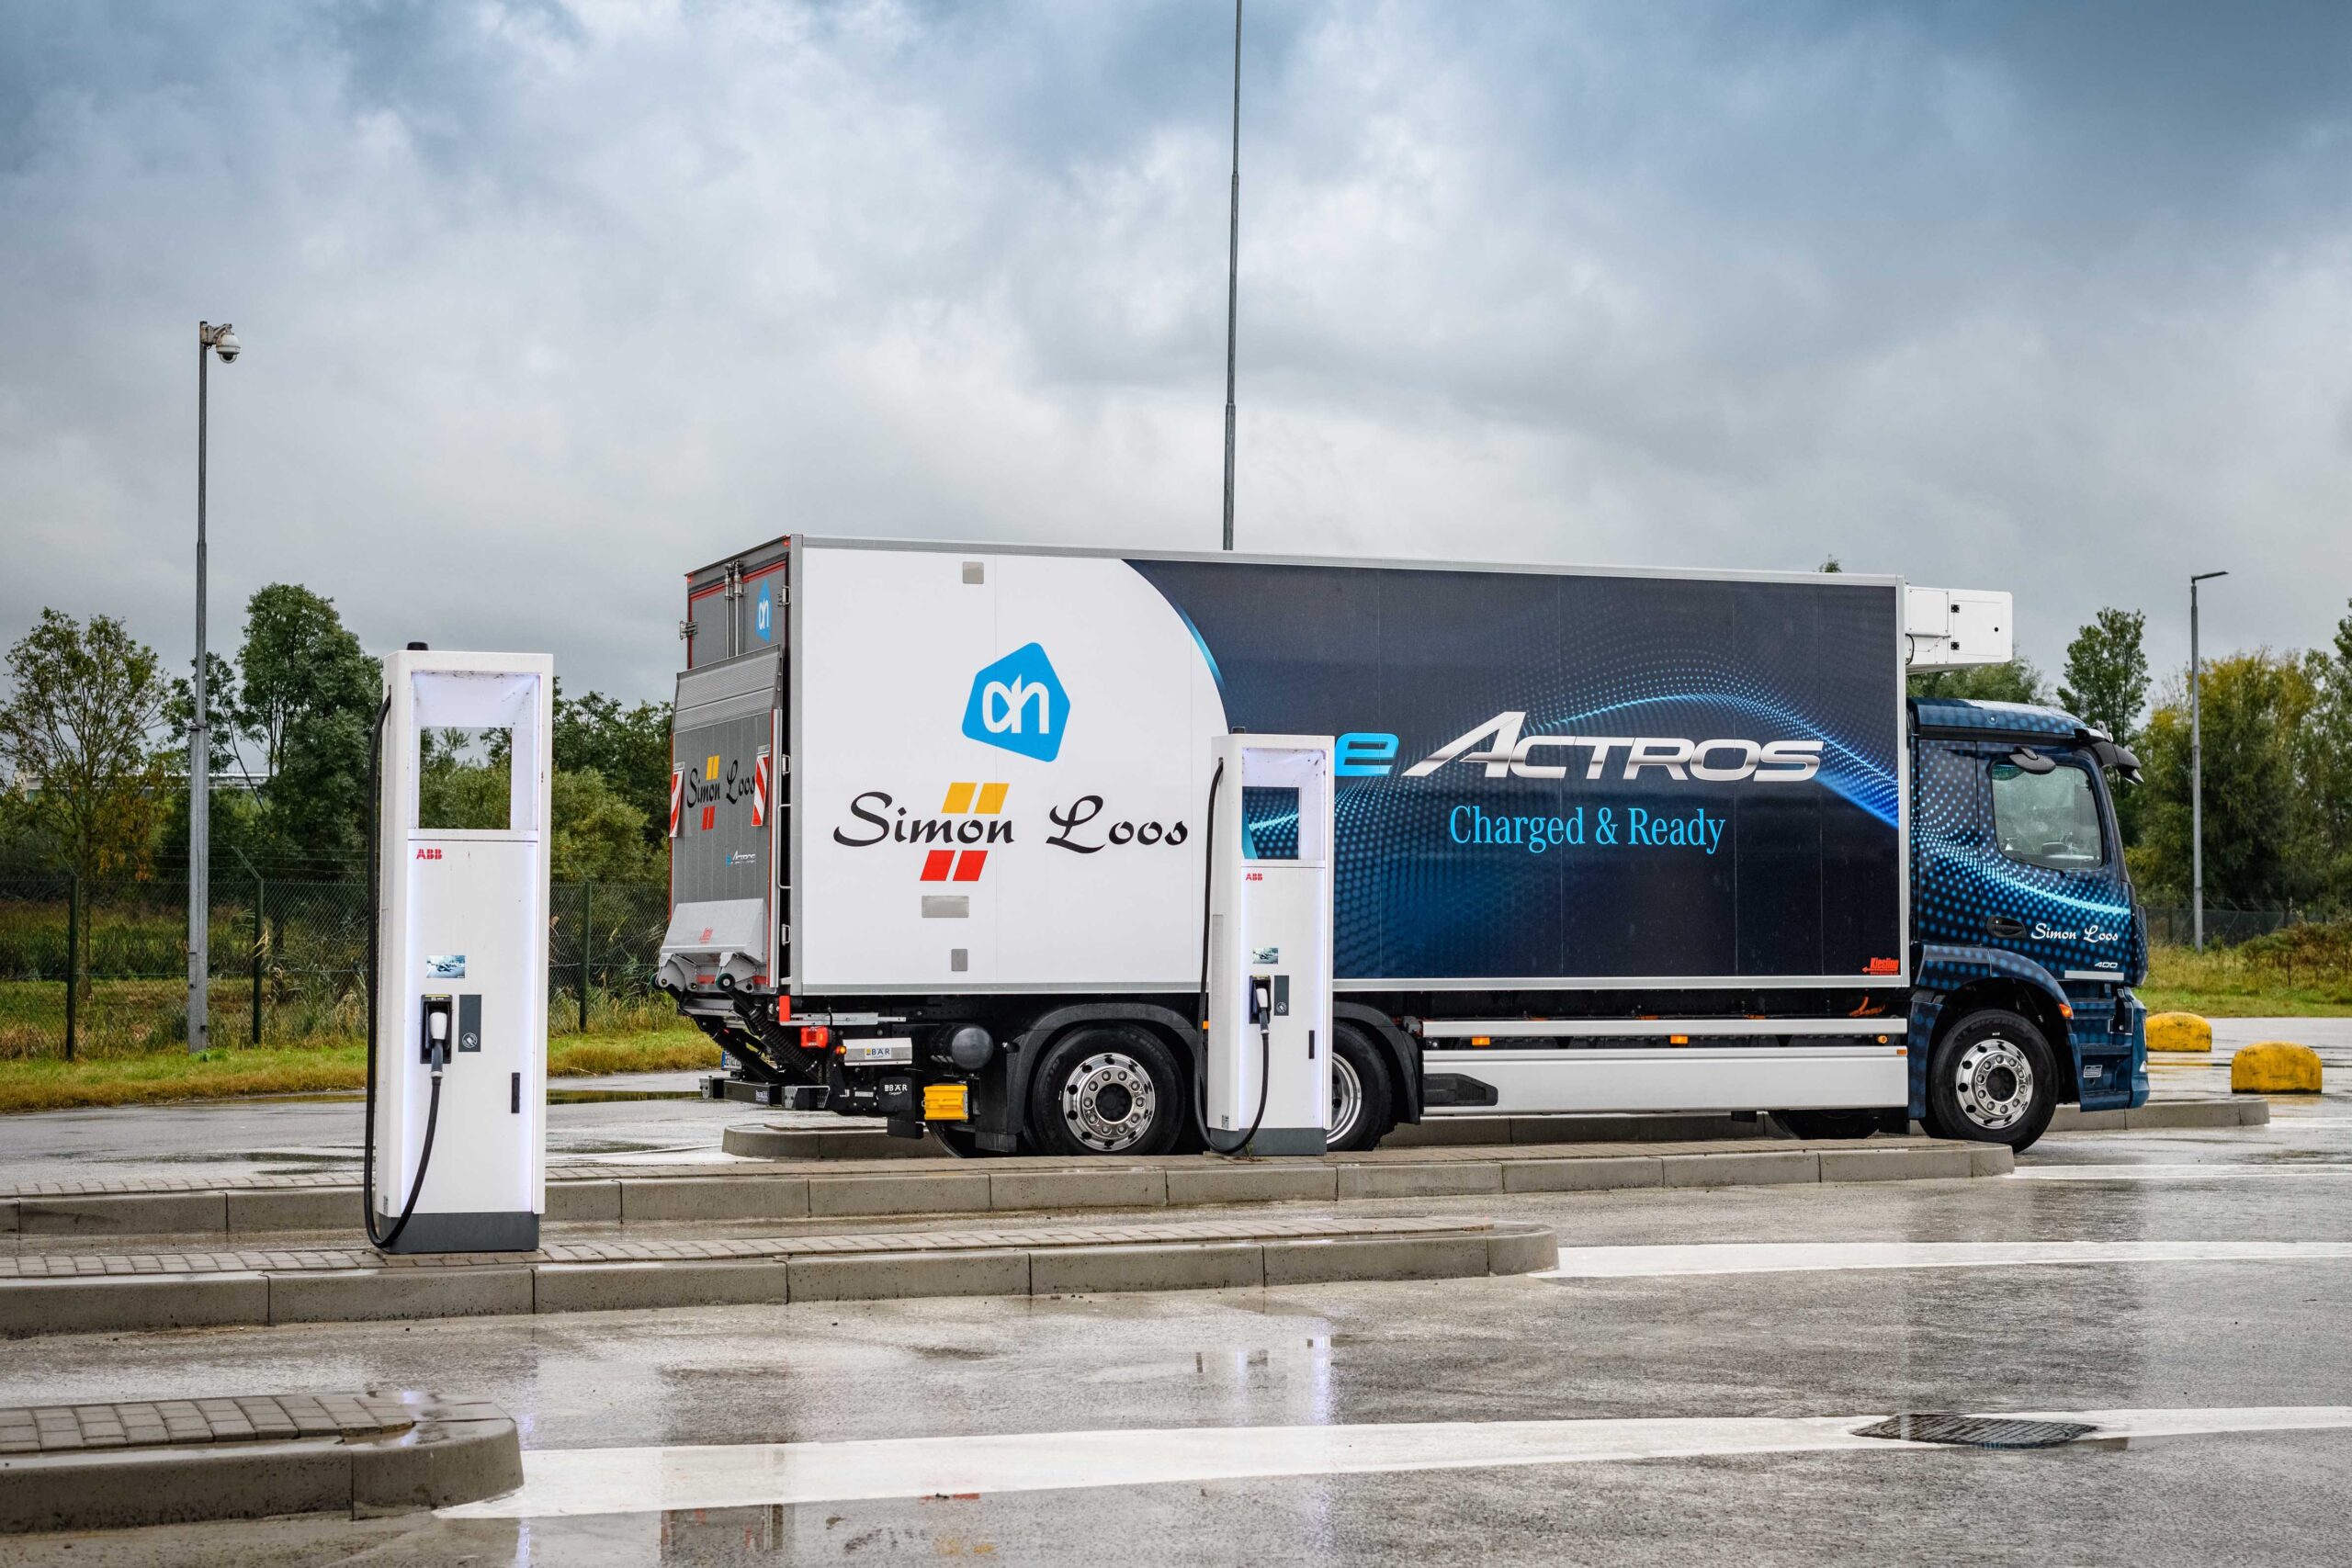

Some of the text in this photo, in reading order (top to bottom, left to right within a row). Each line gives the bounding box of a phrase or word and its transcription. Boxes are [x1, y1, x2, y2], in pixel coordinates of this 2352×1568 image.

[686, 767, 721, 809] Simon
[832, 791, 1188, 854] Simon Loos
[1450, 805, 1726, 854] Charged & Ready
[416, 848, 443, 860] ABB
[1246, 873, 1263, 882] ABB
[2030, 922, 2119, 943] Simon Loos
[2095, 961, 2118, 969] 400
